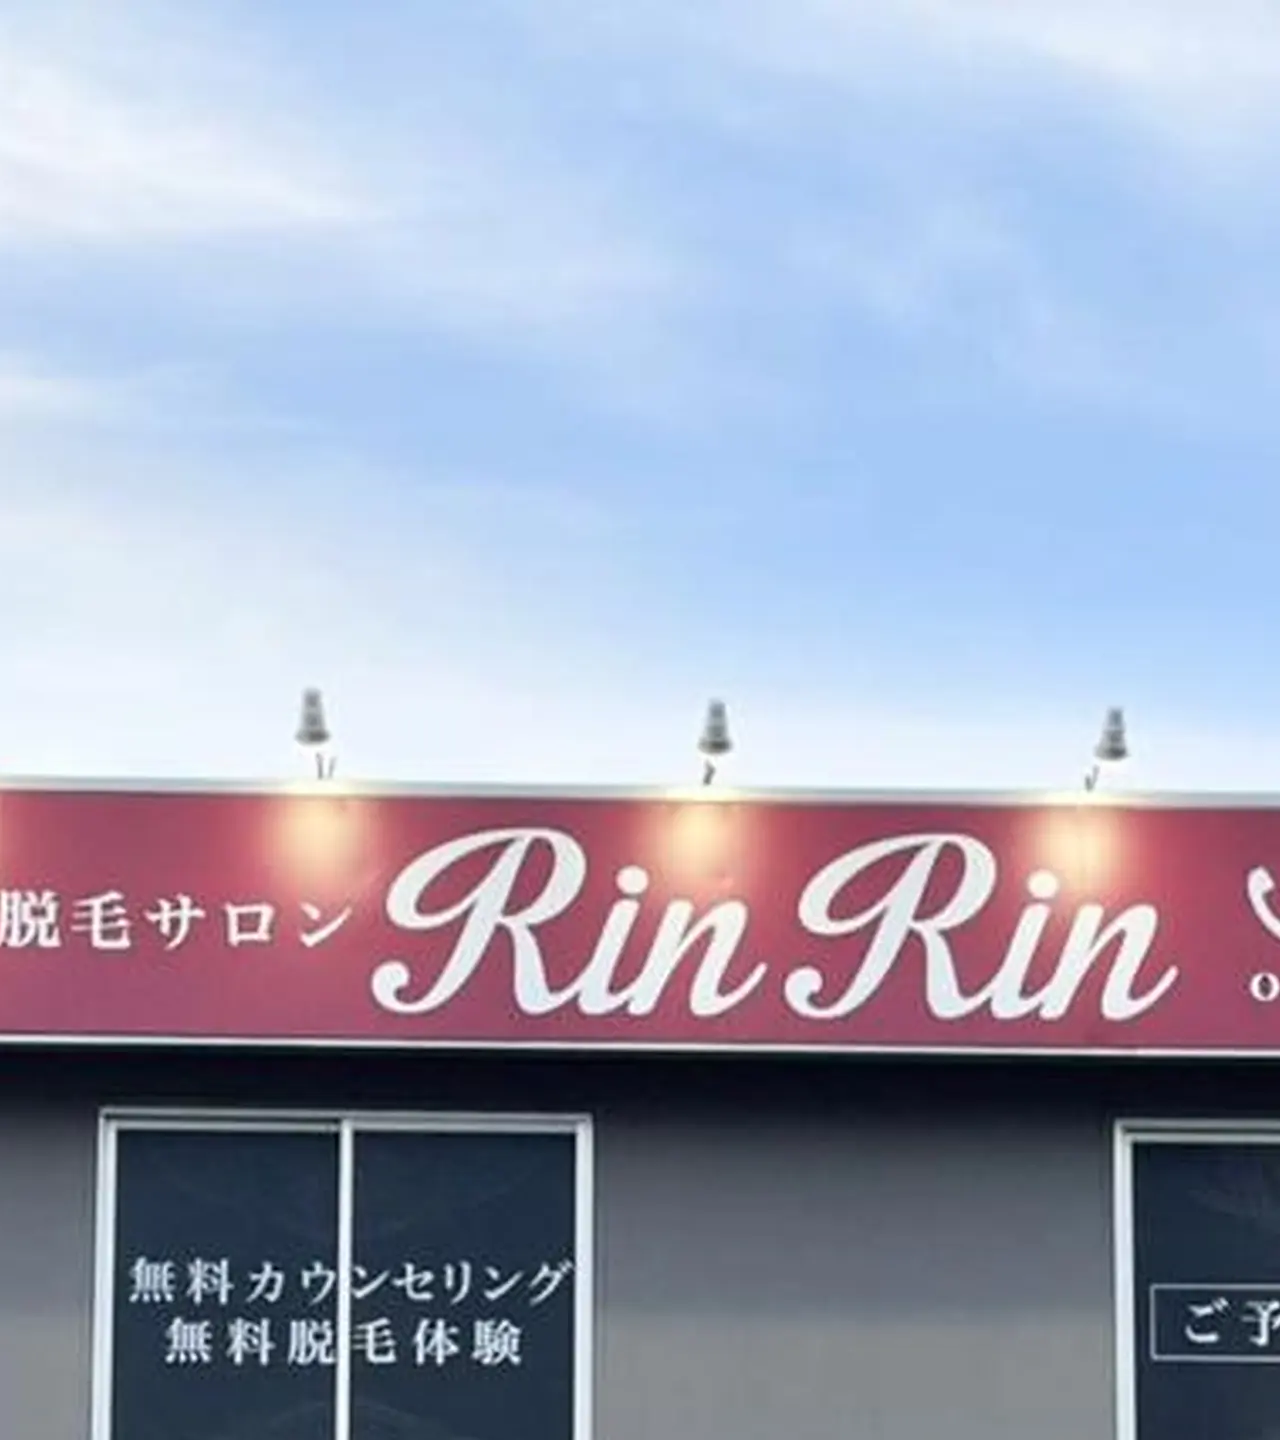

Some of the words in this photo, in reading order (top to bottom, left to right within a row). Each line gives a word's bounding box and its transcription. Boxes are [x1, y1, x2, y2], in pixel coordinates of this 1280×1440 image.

[371, 827, 767, 1018] Rin
[784, 833, 1178, 1021] Rin
[129, 1256, 573, 1305] 無料カウンセリング
[165, 1316, 521, 1366] 無料脱毛体験
